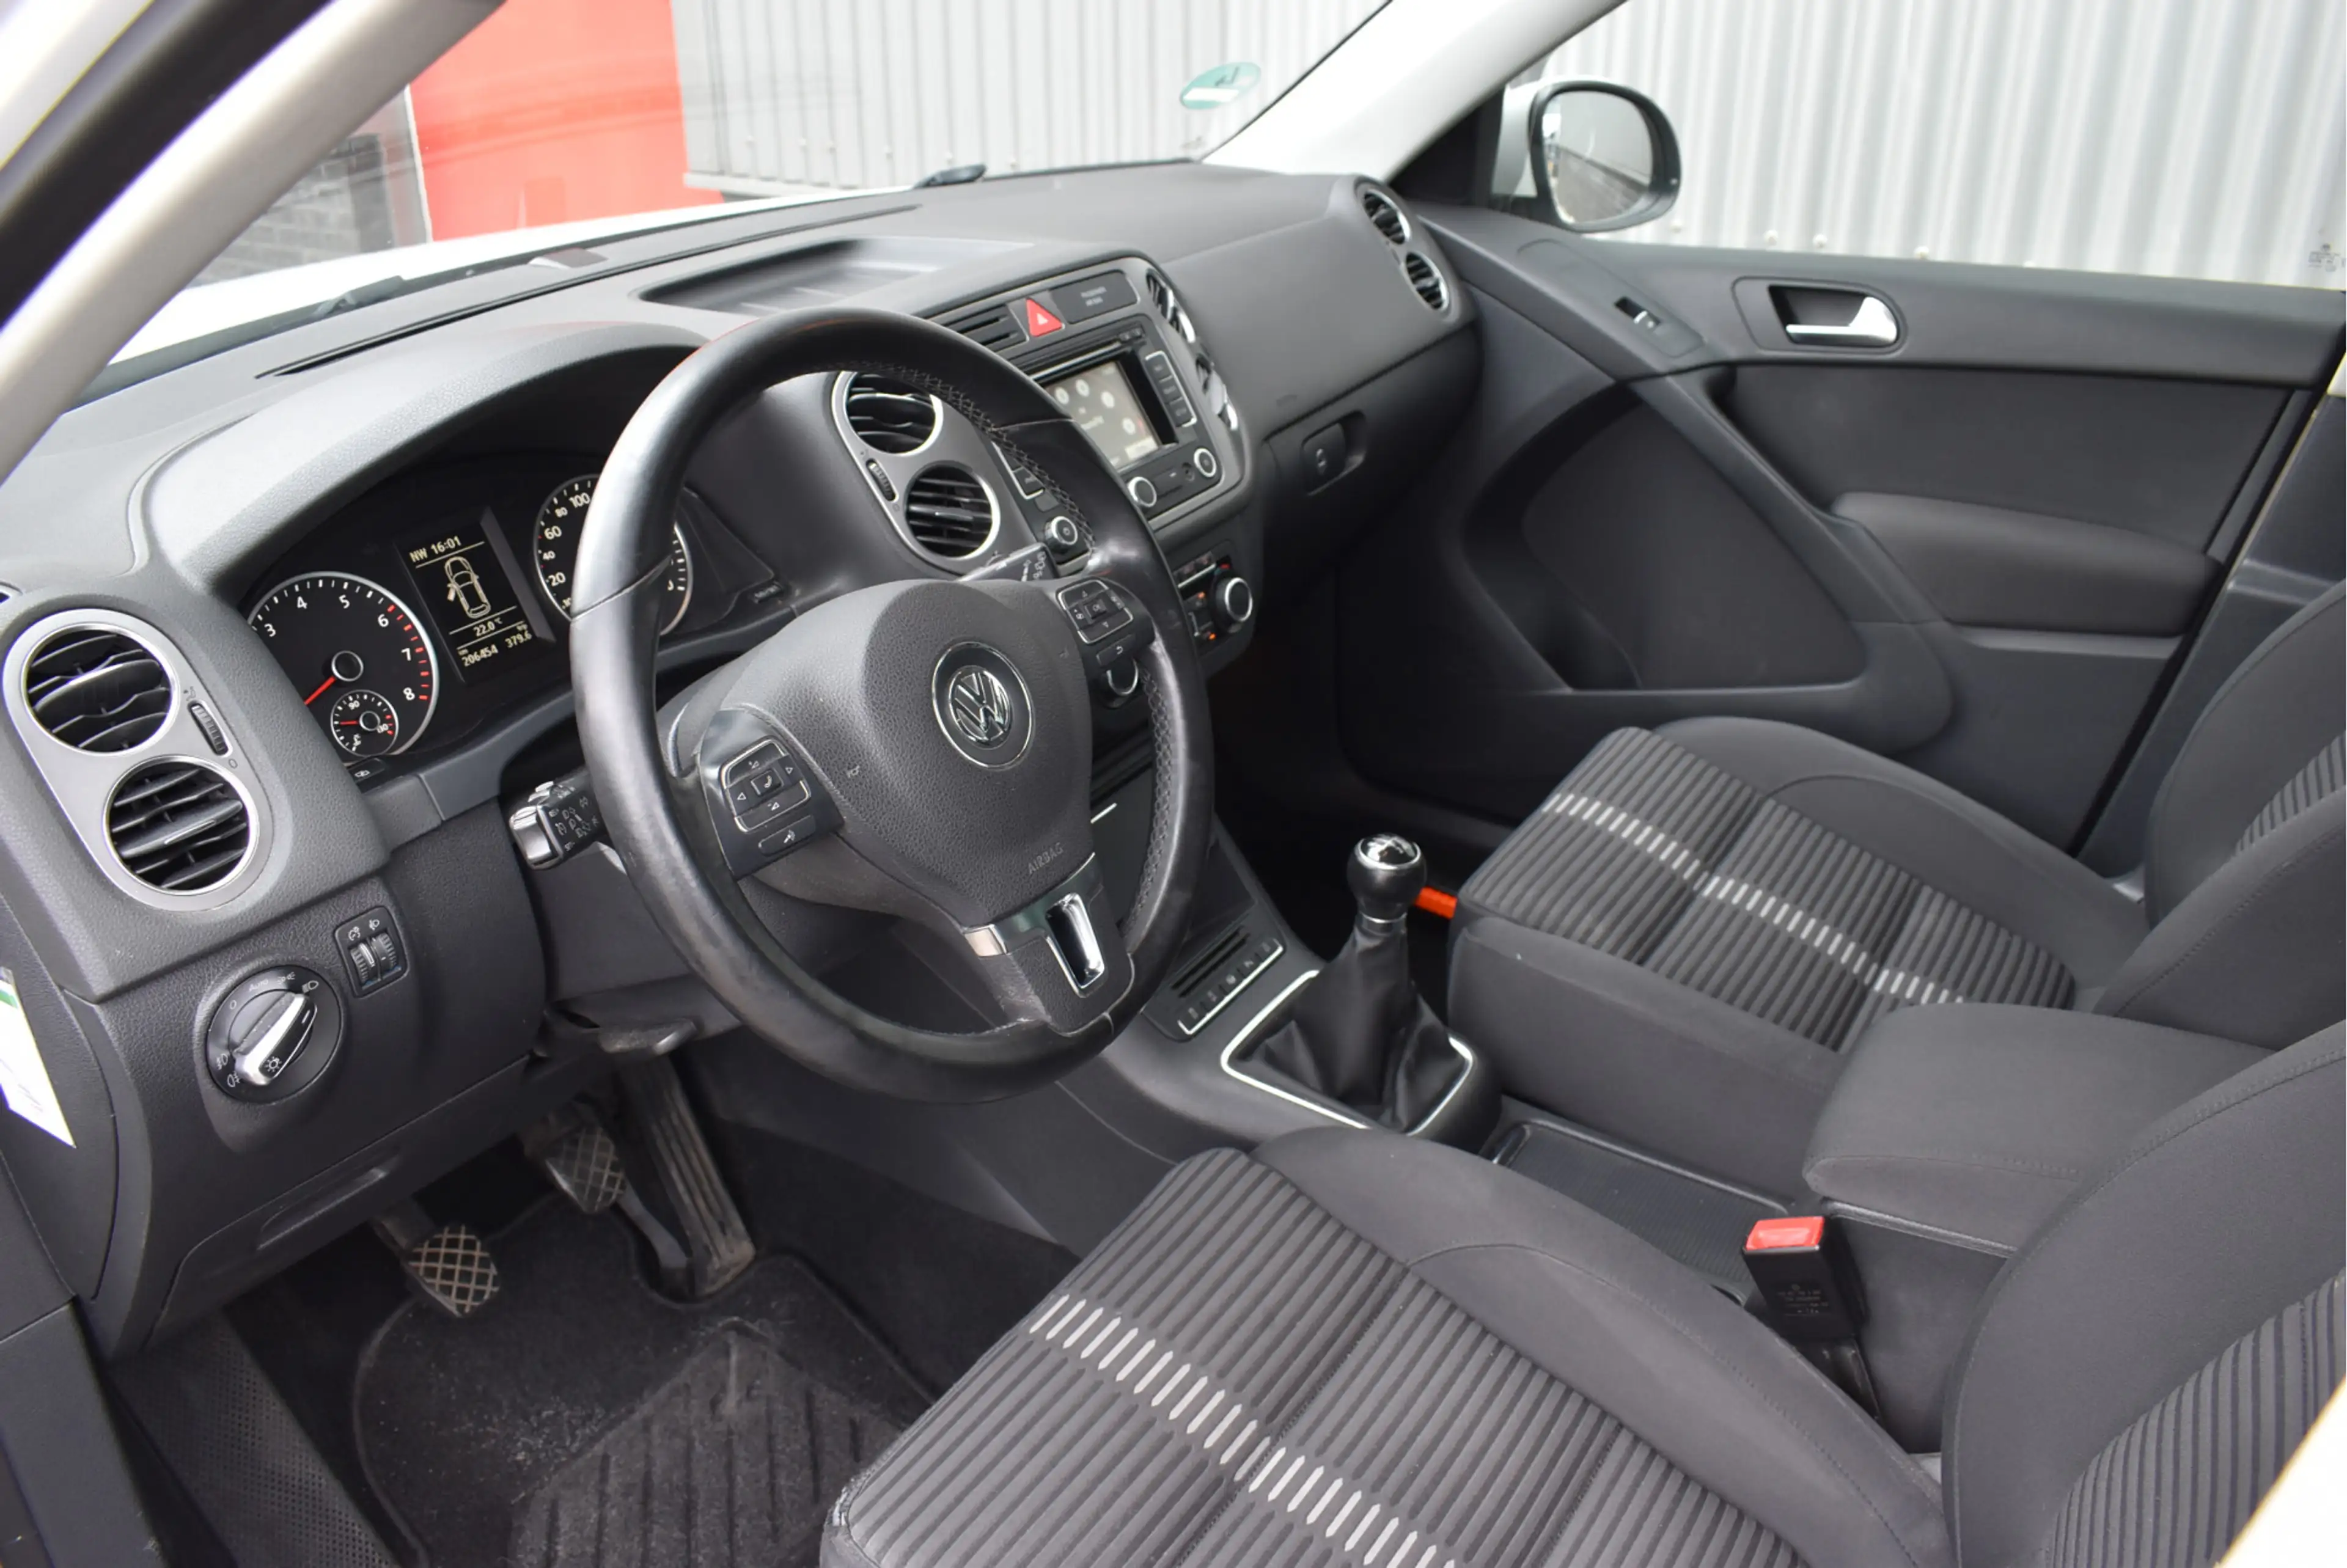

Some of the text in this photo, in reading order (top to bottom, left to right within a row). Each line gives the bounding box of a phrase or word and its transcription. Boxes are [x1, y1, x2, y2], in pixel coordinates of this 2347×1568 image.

[568, 493, 590, 508] 100
[554, 507, 568, 518] 80
[544, 526, 562, 540] 60
[409, 535, 461, 562] NW 16:01
[542, 551, 556, 560] 40
[548, 572, 566, 587] 20
[297, 596, 307, 609] 4
[338, 595, 350, 609] 5
[378, 614, 389, 627] 6
[265, 623, 276, 637] 3
[473, 621, 496, 637] 22.0
[401, 647, 412, 661] 7
[461, 630, 532, 667] 206454 379.6
[403, 687, 416, 700] 8
[348, 700, 361, 711] 90
[1028, 842, 1064, 875] AIRBAG
